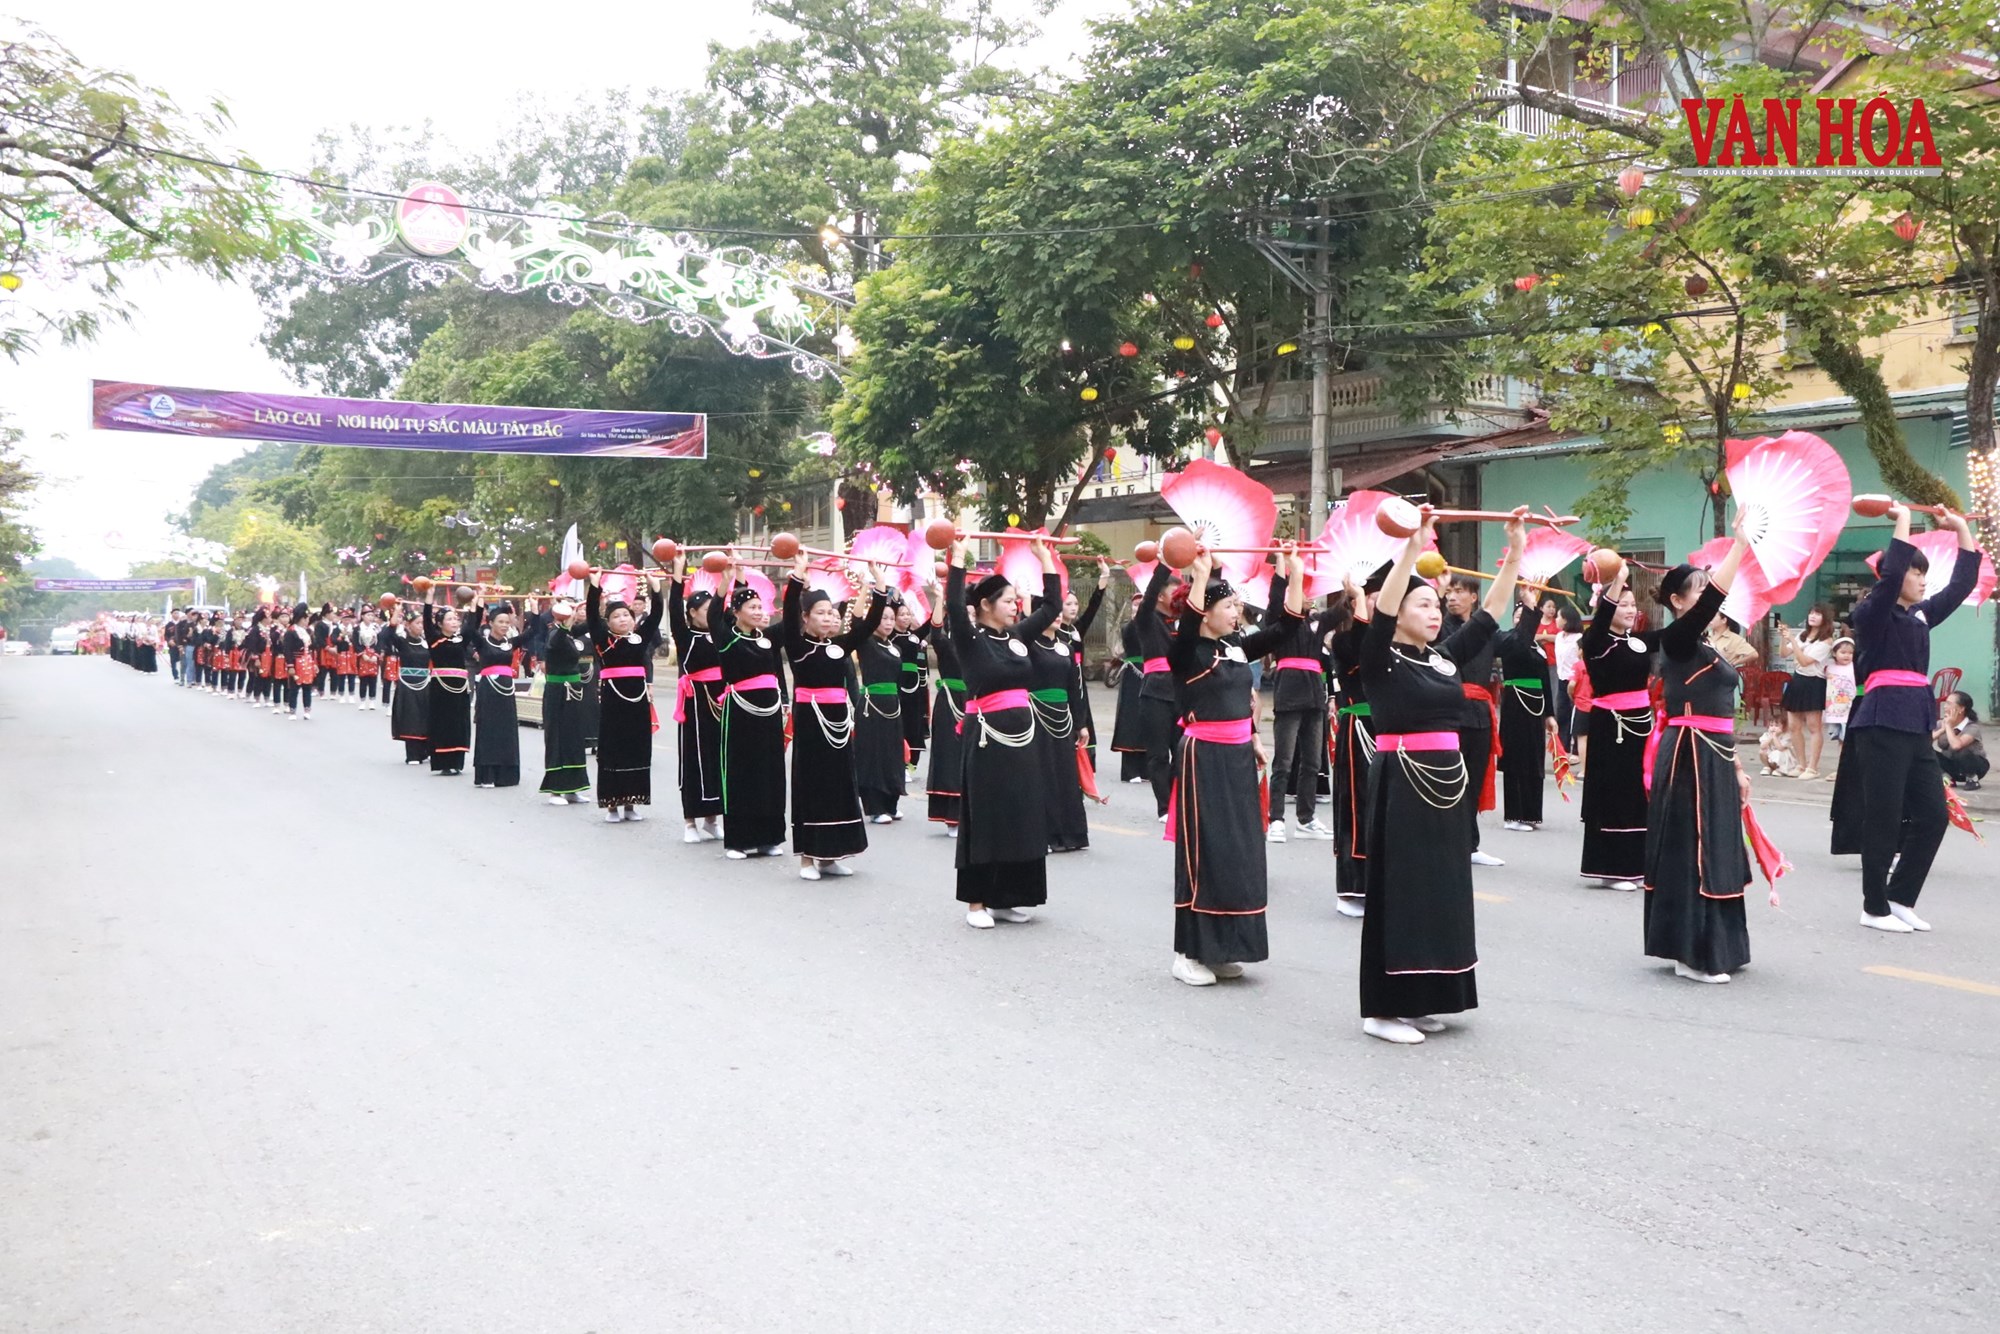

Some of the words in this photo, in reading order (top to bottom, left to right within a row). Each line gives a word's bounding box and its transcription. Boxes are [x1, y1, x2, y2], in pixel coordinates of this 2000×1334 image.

[254, 408, 289, 425] LÀO
[292, 411, 321, 427] CAI
[337, 414, 366, 429] NƠI
[370, 414, 399, 433] HỘI
[403, 418, 425, 434] TỤ
[428, 415, 460, 434] SẮC
[462, 419, 498, 435] MÀU
[501, 420, 530, 436] TÂY
[532, 420, 564, 437] BẮC
